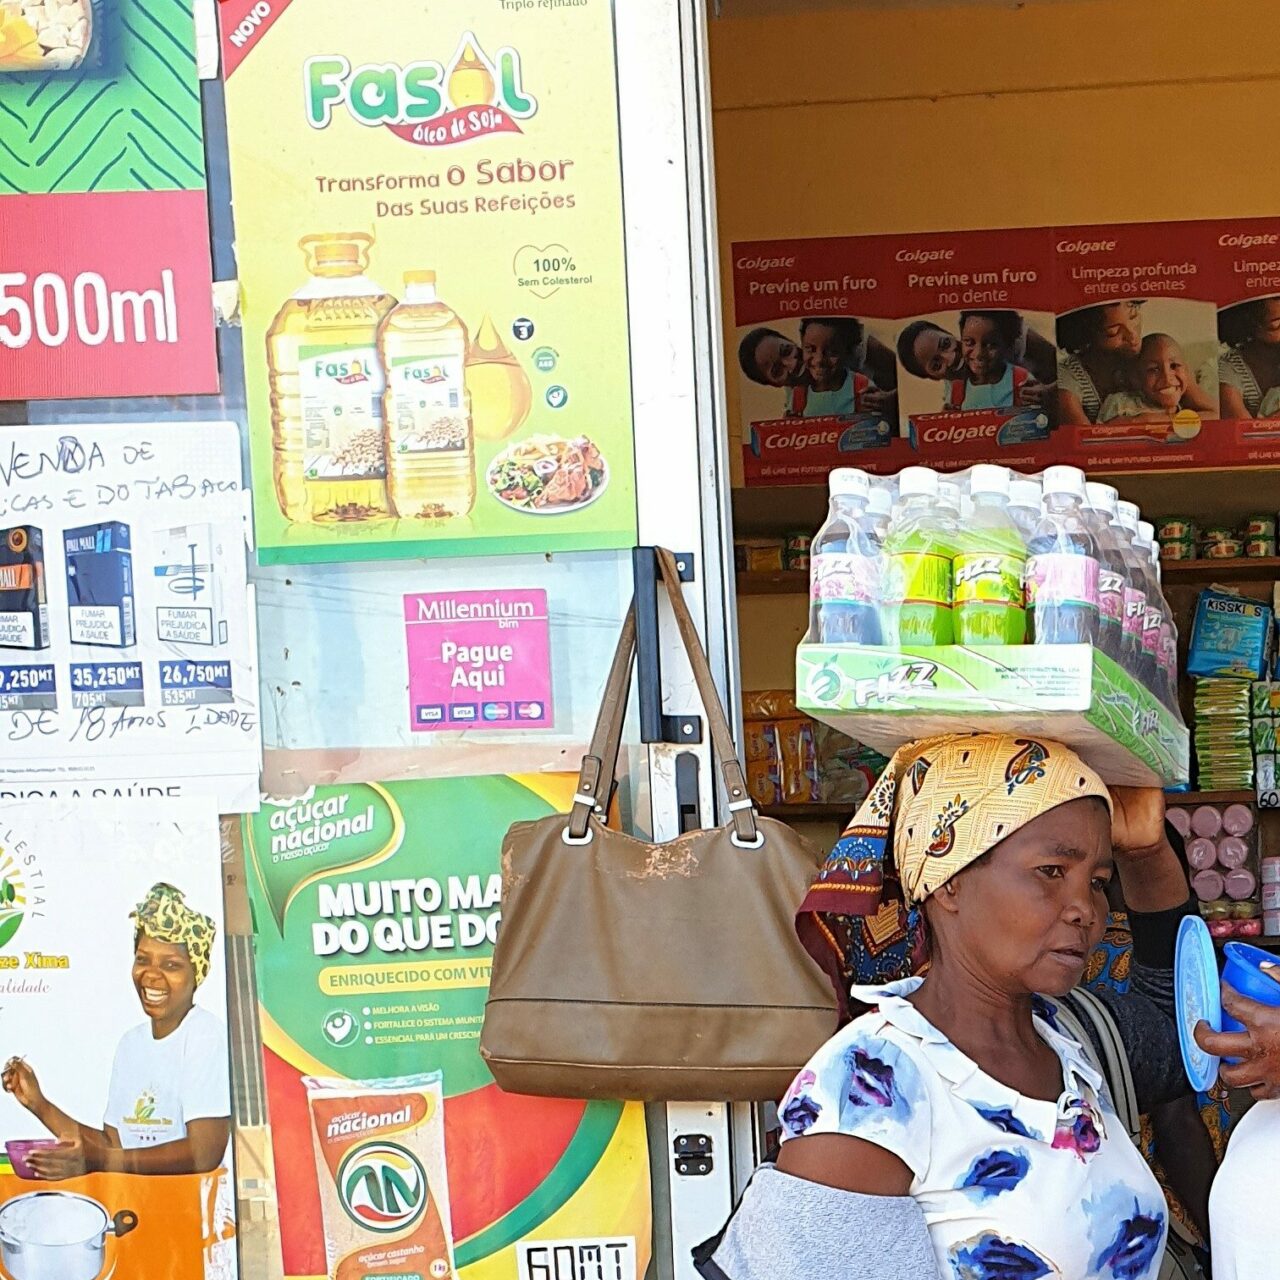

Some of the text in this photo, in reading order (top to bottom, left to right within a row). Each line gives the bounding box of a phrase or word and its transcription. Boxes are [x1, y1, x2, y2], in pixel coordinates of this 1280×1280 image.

[229, 2, 272, 48] NOVO
[450, 114, 468, 136] de
[470, 109, 502, 132] Soja
[315, 158, 574, 193] Transforma Sabor
[376, 191, 576, 218] Das Suas Refeições
[1056, 240, 1116, 255] Colgate
[1218, 233, 1279, 249] Colgate
[533, 257, 576, 273] 100%
[736, 256, 795, 272] Colgate
[895, 249, 954, 264] Colgate
[908, 268, 1037, 288] Previne um furo
[1072, 262, 1197, 281] Limpeza profunda
[518, 275, 592, 288] Sem Colesterol
[749, 275, 877, 296] Previne um furo
[1084, 278, 1185, 295] entre os dentes
[1246, 276, 1280, 288] entre
[779, 297, 848, 311] no dente
[938, 289, 1008, 304] no dente
[0, 268, 178, 348] 500ml
[765, 431, 838, 450] Colgate
[923, 423, 997, 443] Colgate
[955, 558, 1001, 587] FIZZ
[167, 611, 197, 620] FUMAR
[417, 598, 533, 621] Millennium
[499, 619, 519, 629] bim
[441, 641, 513, 668] Pague
[73, 666, 141, 688] 35,250MT
[162, 665, 228, 685] 26,750MT
[451, 665, 505, 692] Aqui
[75, 693, 106, 706] 705MT
[164, 691, 196, 704] 535MT
[1258, 791, 1279, 808] 60
[270, 794, 349, 832] açúcar
[271, 805, 374, 854] nacional
[2, 828, 46, 918] LESTIAL
[318, 874, 502, 919] MUITO MA
[312, 912, 499, 957] DO QUE DO
[24, 951, 69, 969] Xima
[0, 978, 51, 994] alidade
[330, 966, 493, 988] ENRIQUECIDO COM VIT
[372, 1006, 410, 1015] MELHORA
[416, 1003, 440, 1012] VISÃO
[373, 1020, 416, 1029] FORTALECE
[423, 1018, 455, 1027] SISTEMA
[375, 1035, 415, 1044] ESSENCIAL
[415, 1033, 435, 1041] PARA
[436, 1032, 448, 1040] UM
[327, 1104, 411, 1138] nacional
[387, 1244, 424, 1258] castanho
